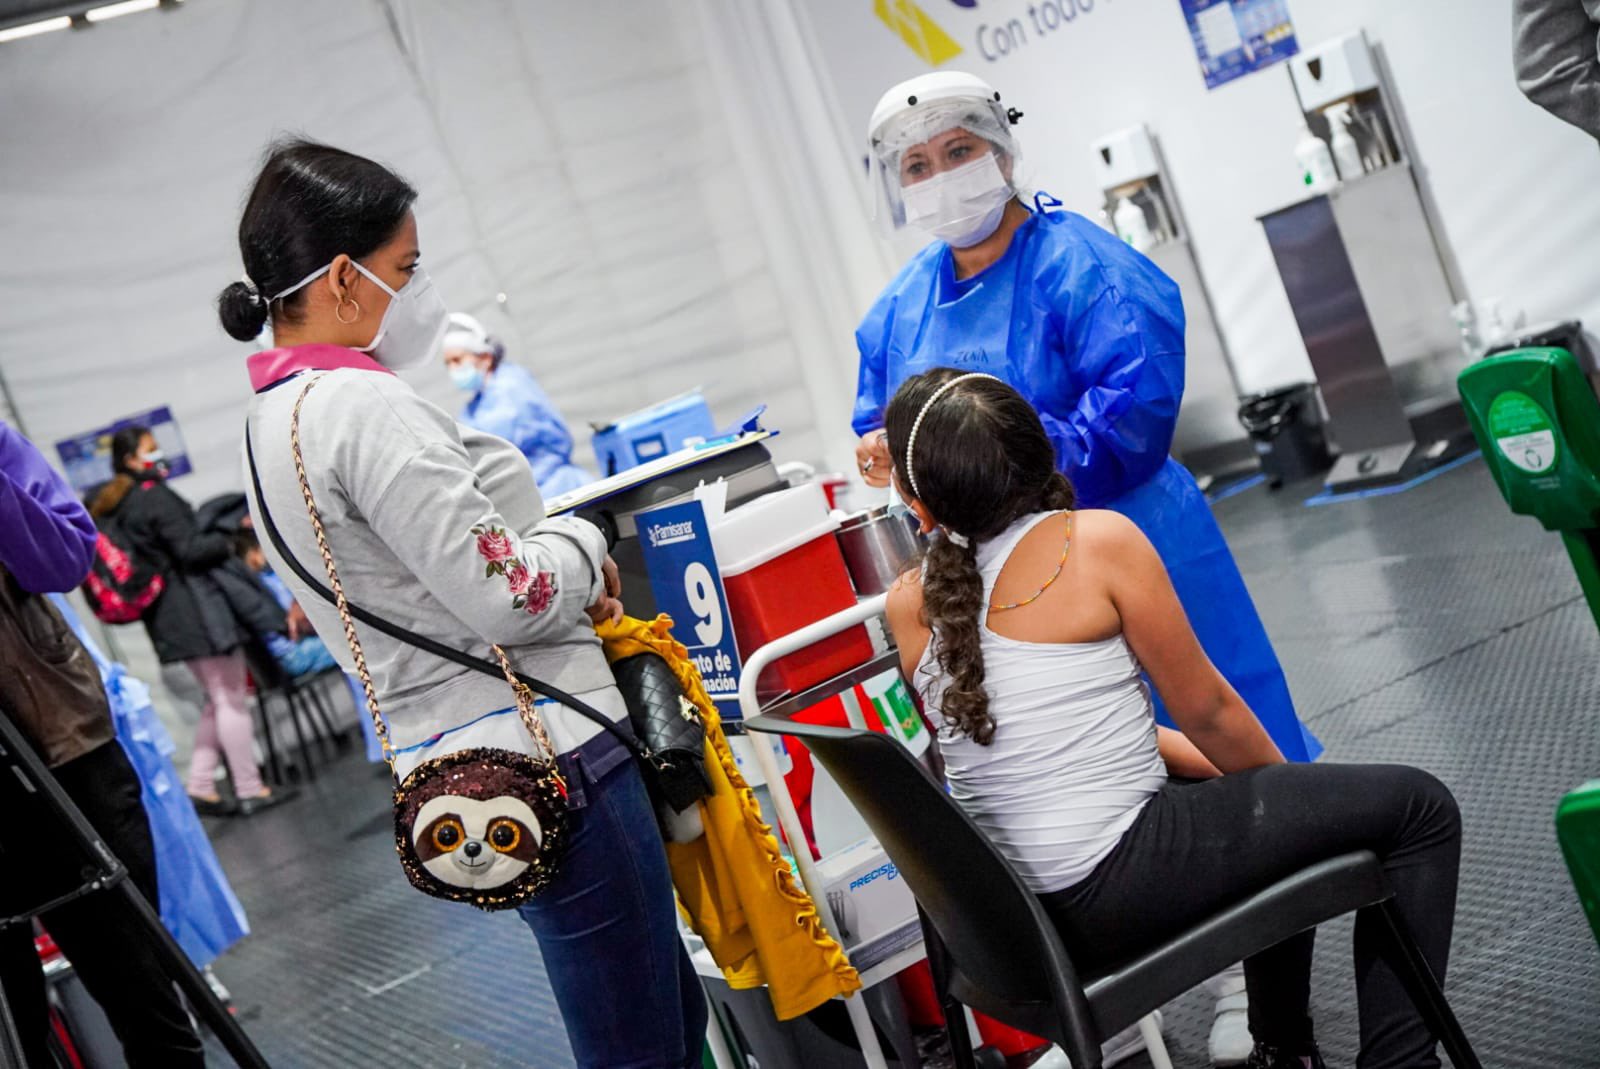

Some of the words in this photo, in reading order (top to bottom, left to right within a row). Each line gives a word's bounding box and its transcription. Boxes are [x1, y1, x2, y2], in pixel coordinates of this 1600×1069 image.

[976, 19, 1027, 62] Con
[654, 520, 693, 540] Famisanar
[684, 561, 724, 648] 9
[692, 654, 713, 673] nto
[714, 649, 732, 671] de
[703, 672, 737, 692] nación
